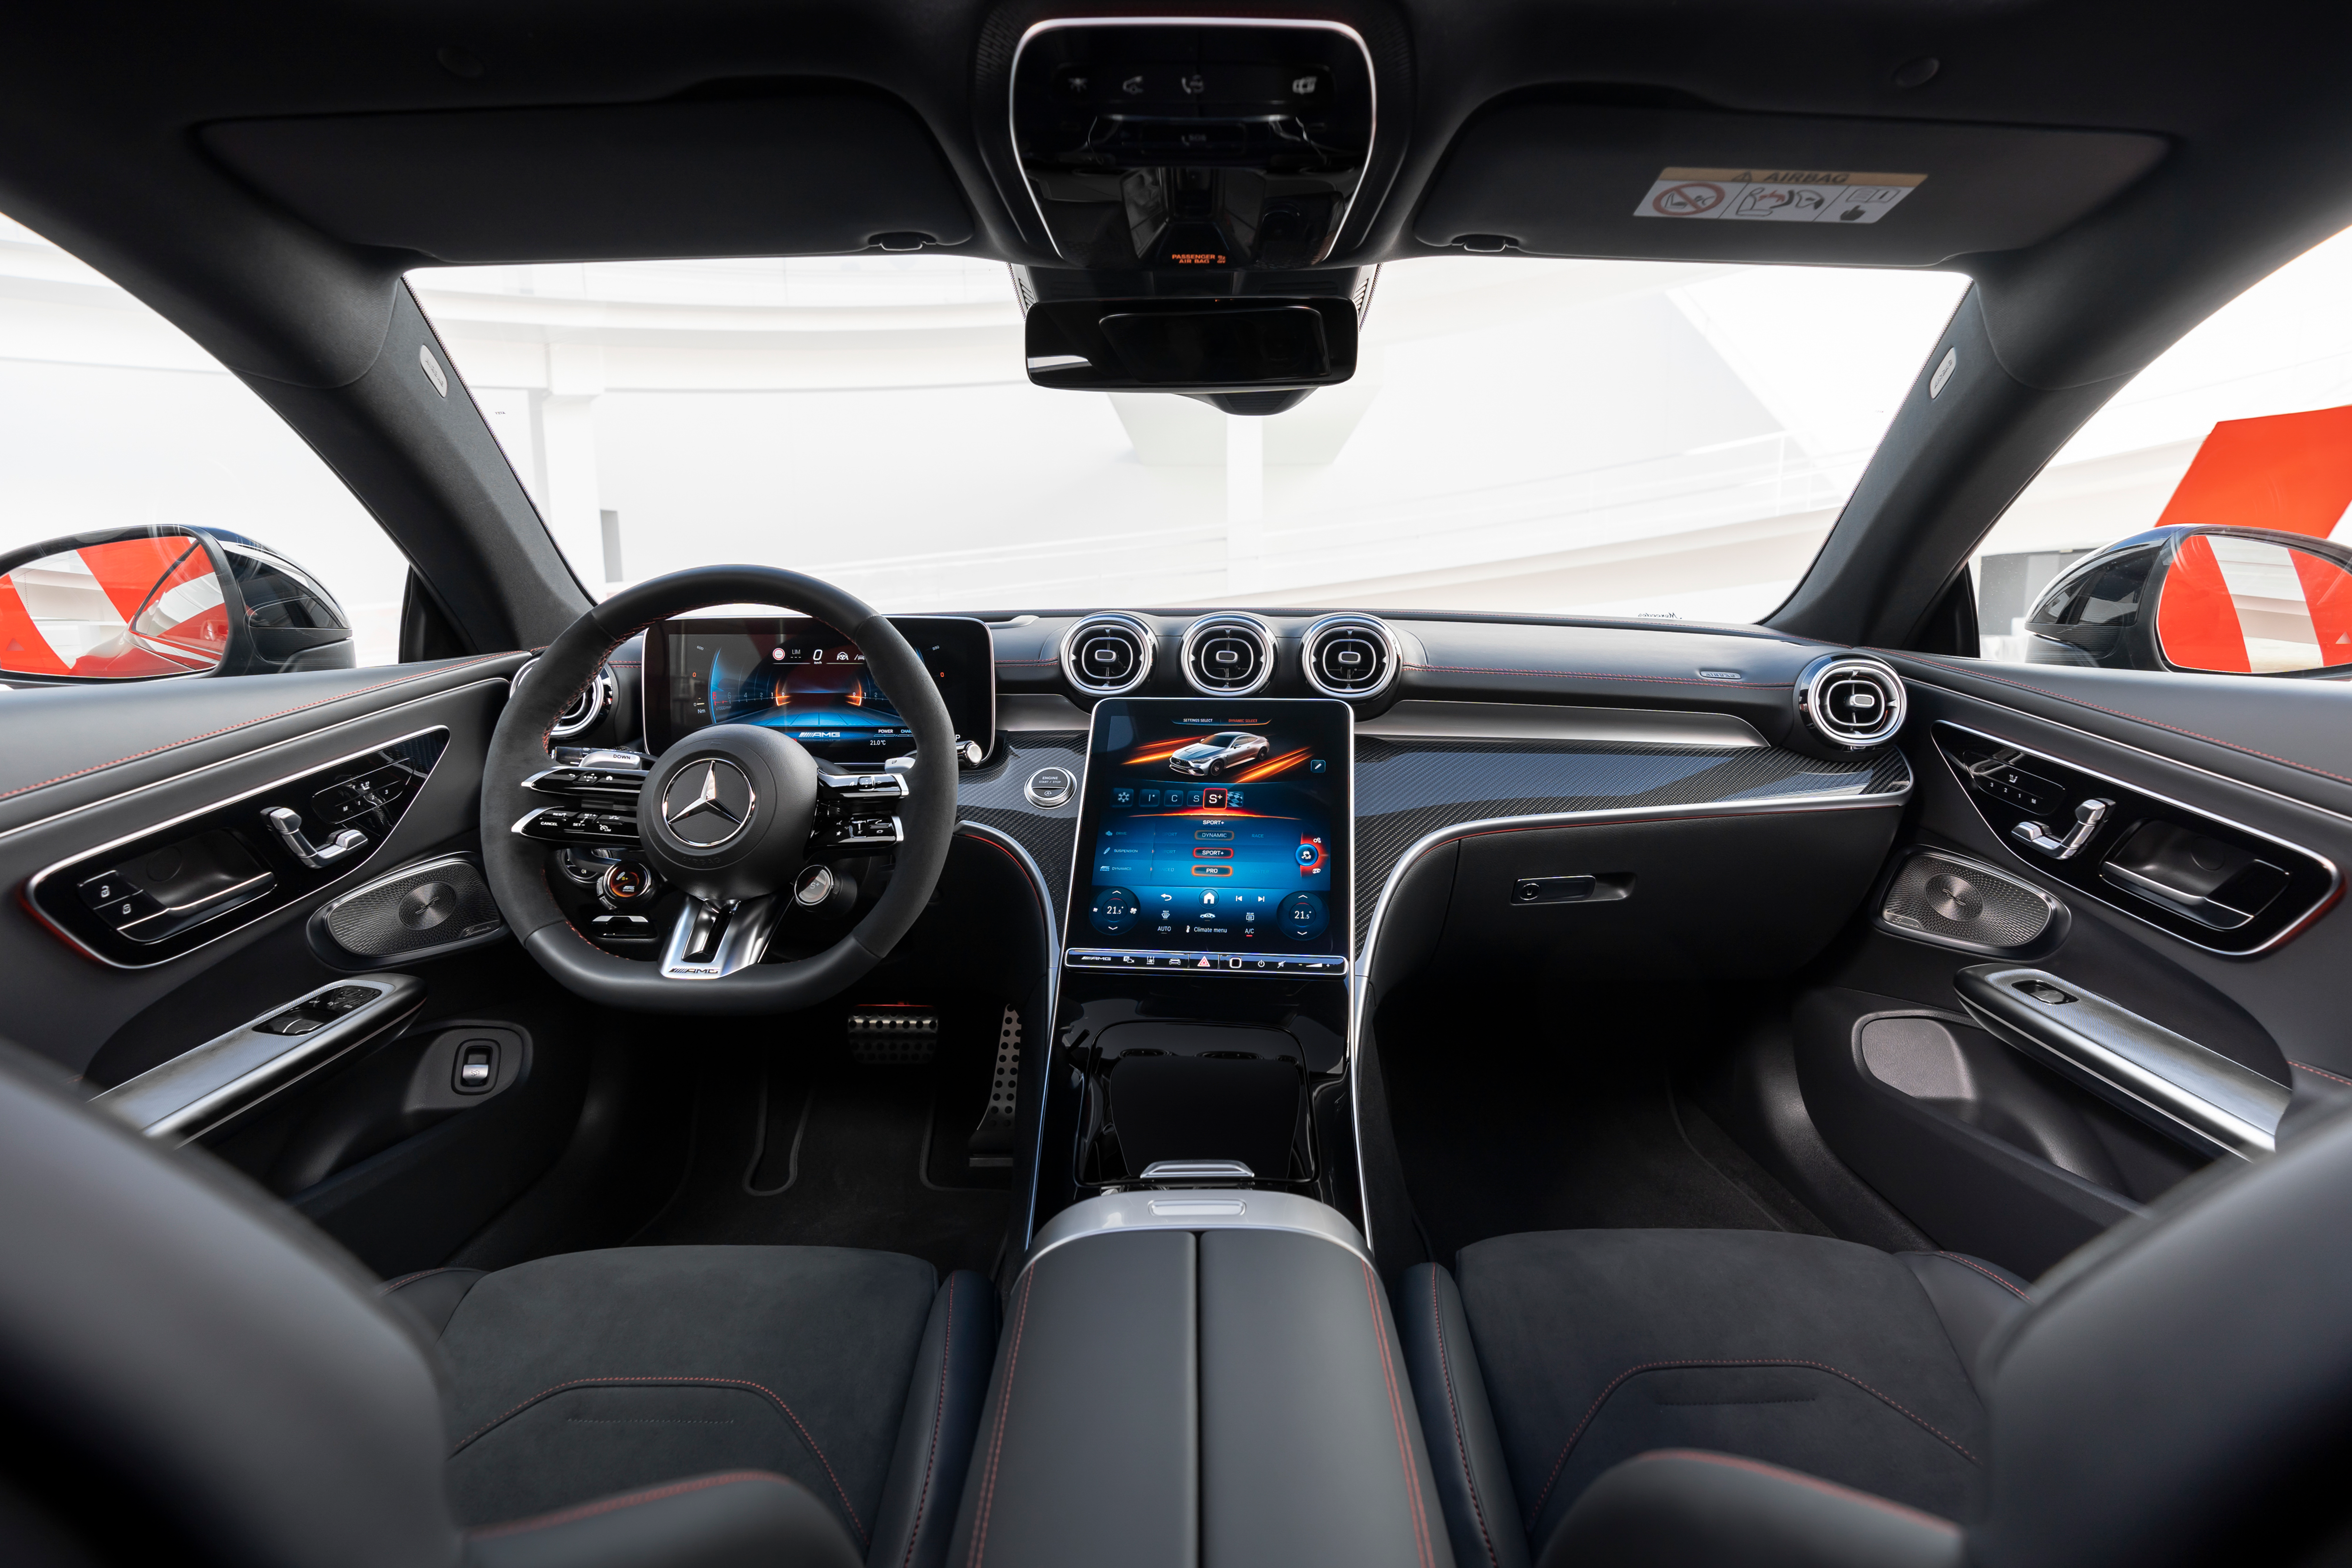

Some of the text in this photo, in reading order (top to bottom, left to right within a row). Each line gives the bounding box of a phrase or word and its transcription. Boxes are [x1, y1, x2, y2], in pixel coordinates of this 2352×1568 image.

[1764, 172, 1851, 183] AIRBAG
[813, 649, 823, 660] 0
[1209, 794, 1223, 804] S+
